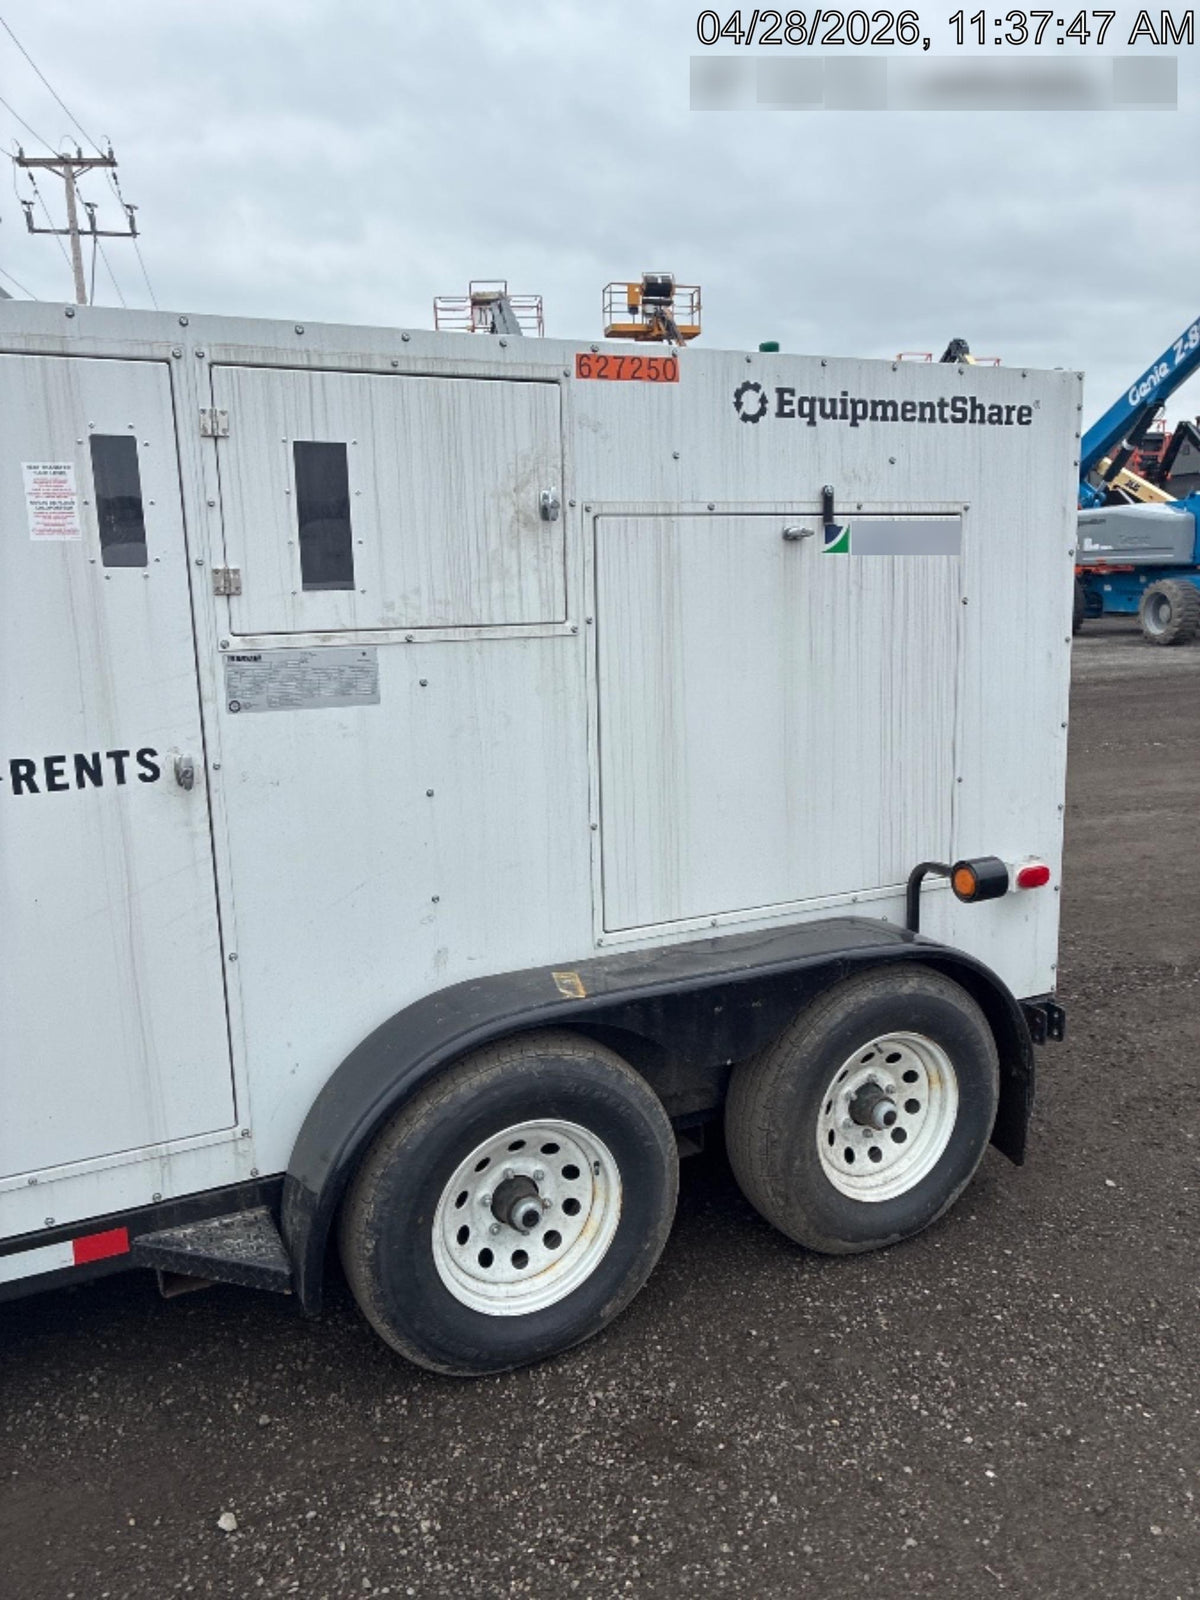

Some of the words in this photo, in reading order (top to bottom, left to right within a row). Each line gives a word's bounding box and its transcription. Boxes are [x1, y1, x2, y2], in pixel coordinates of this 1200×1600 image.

[579, 354, 677, 381] 627250
[1128, 362, 1170, 406] Genie
[1173, 324, 1200, 366] Z-8
[775, 387, 1033, 427] EquipmentShare
[9, 747, 161, 795] RENTS
